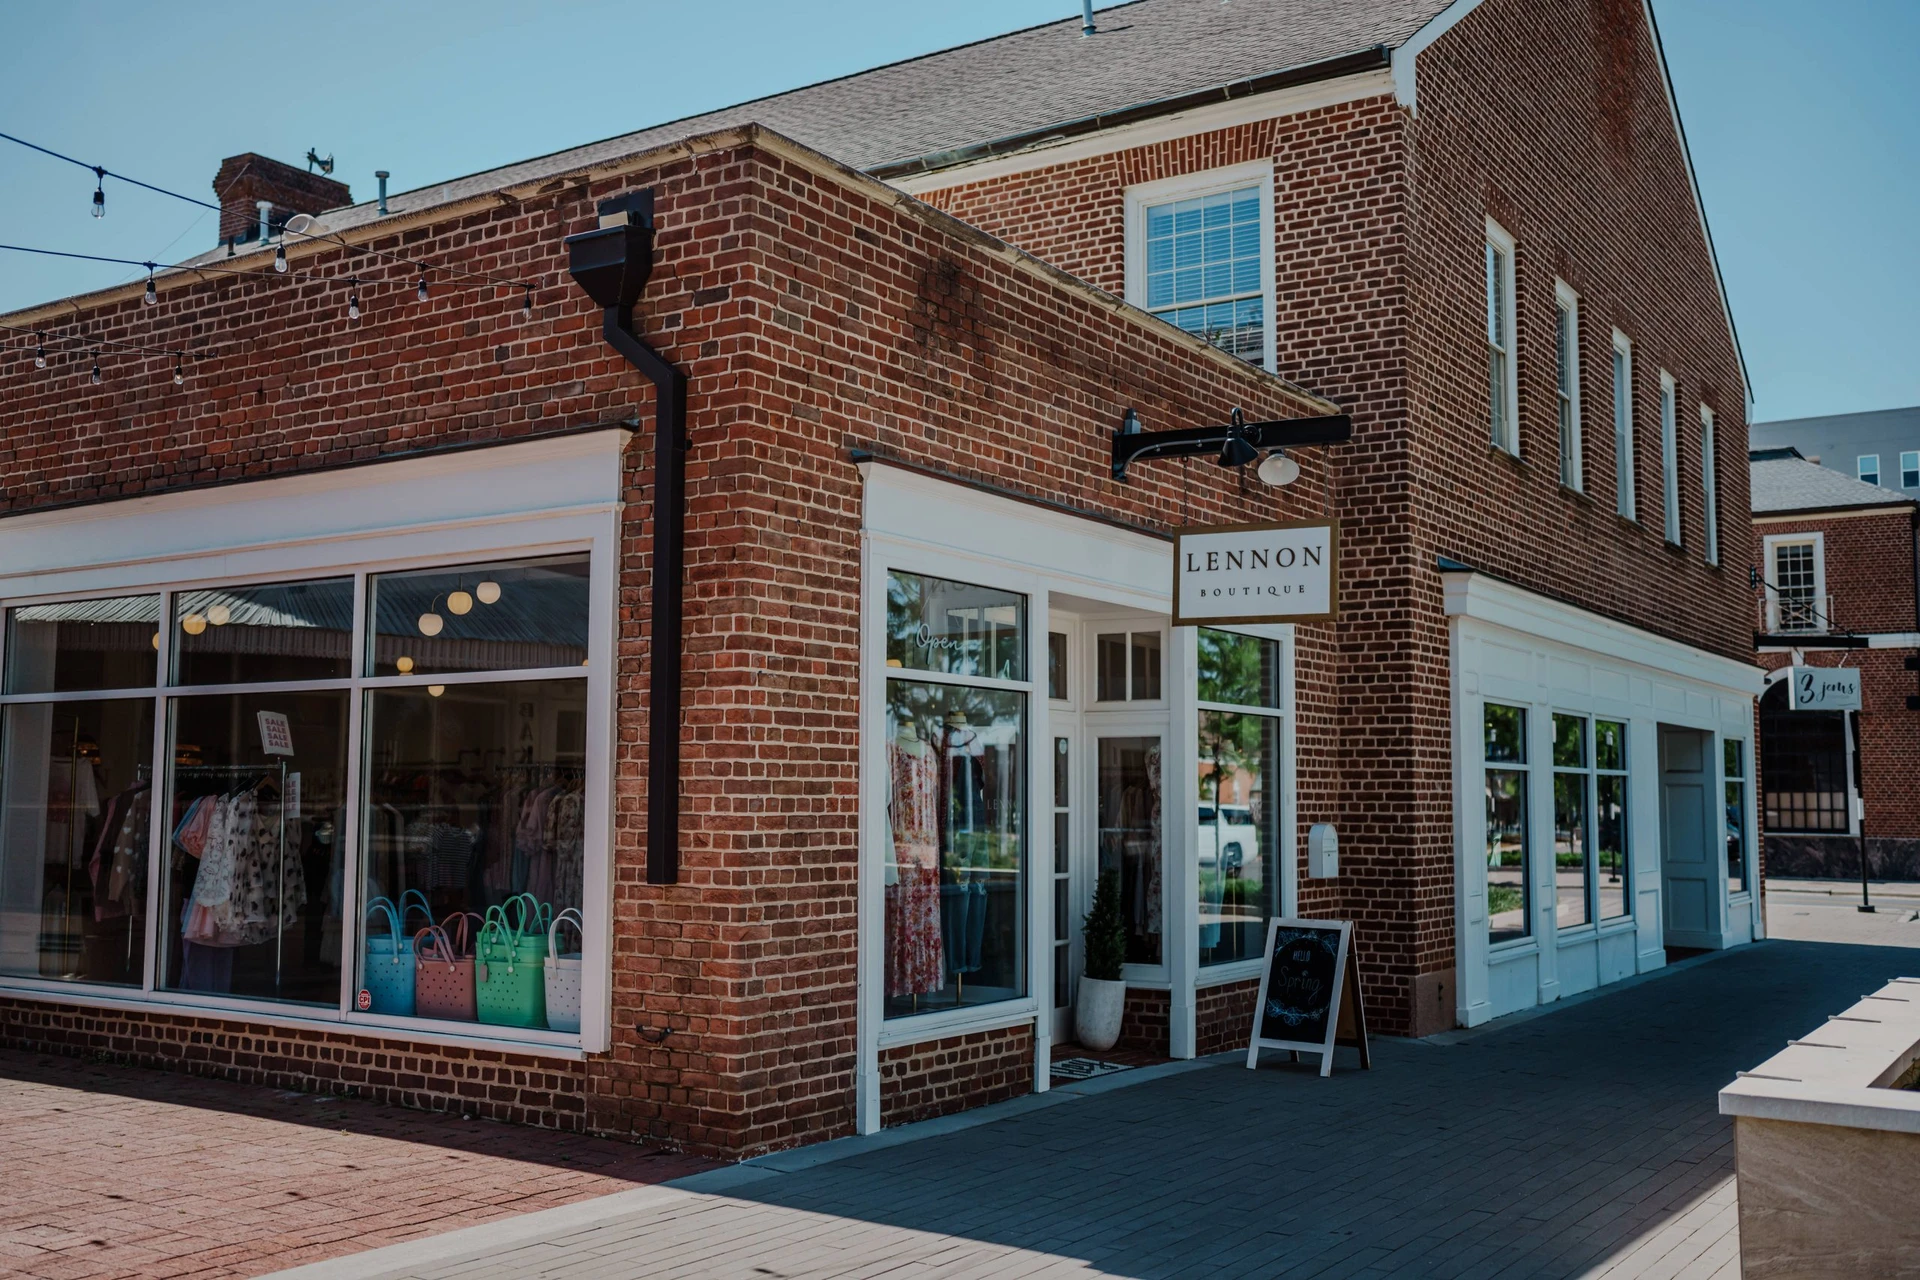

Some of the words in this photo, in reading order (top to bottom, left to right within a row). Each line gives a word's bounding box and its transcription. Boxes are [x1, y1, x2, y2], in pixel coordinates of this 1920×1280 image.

[1186, 546, 1322, 572] LENNON
[1200, 585, 1305, 597] BOUTIQUE
[916, 623, 962, 665] Open
[1800, 673, 1815, 704] 3
[265, 718, 285, 727] SALE
[266, 725, 287, 734] SALE
[267, 732, 288, 741] SALE
[269, 740, 290, 749] SALE
[1292, 950, 1311, 962] HELLO
[1278, 966, 1325, 1006] Spring
